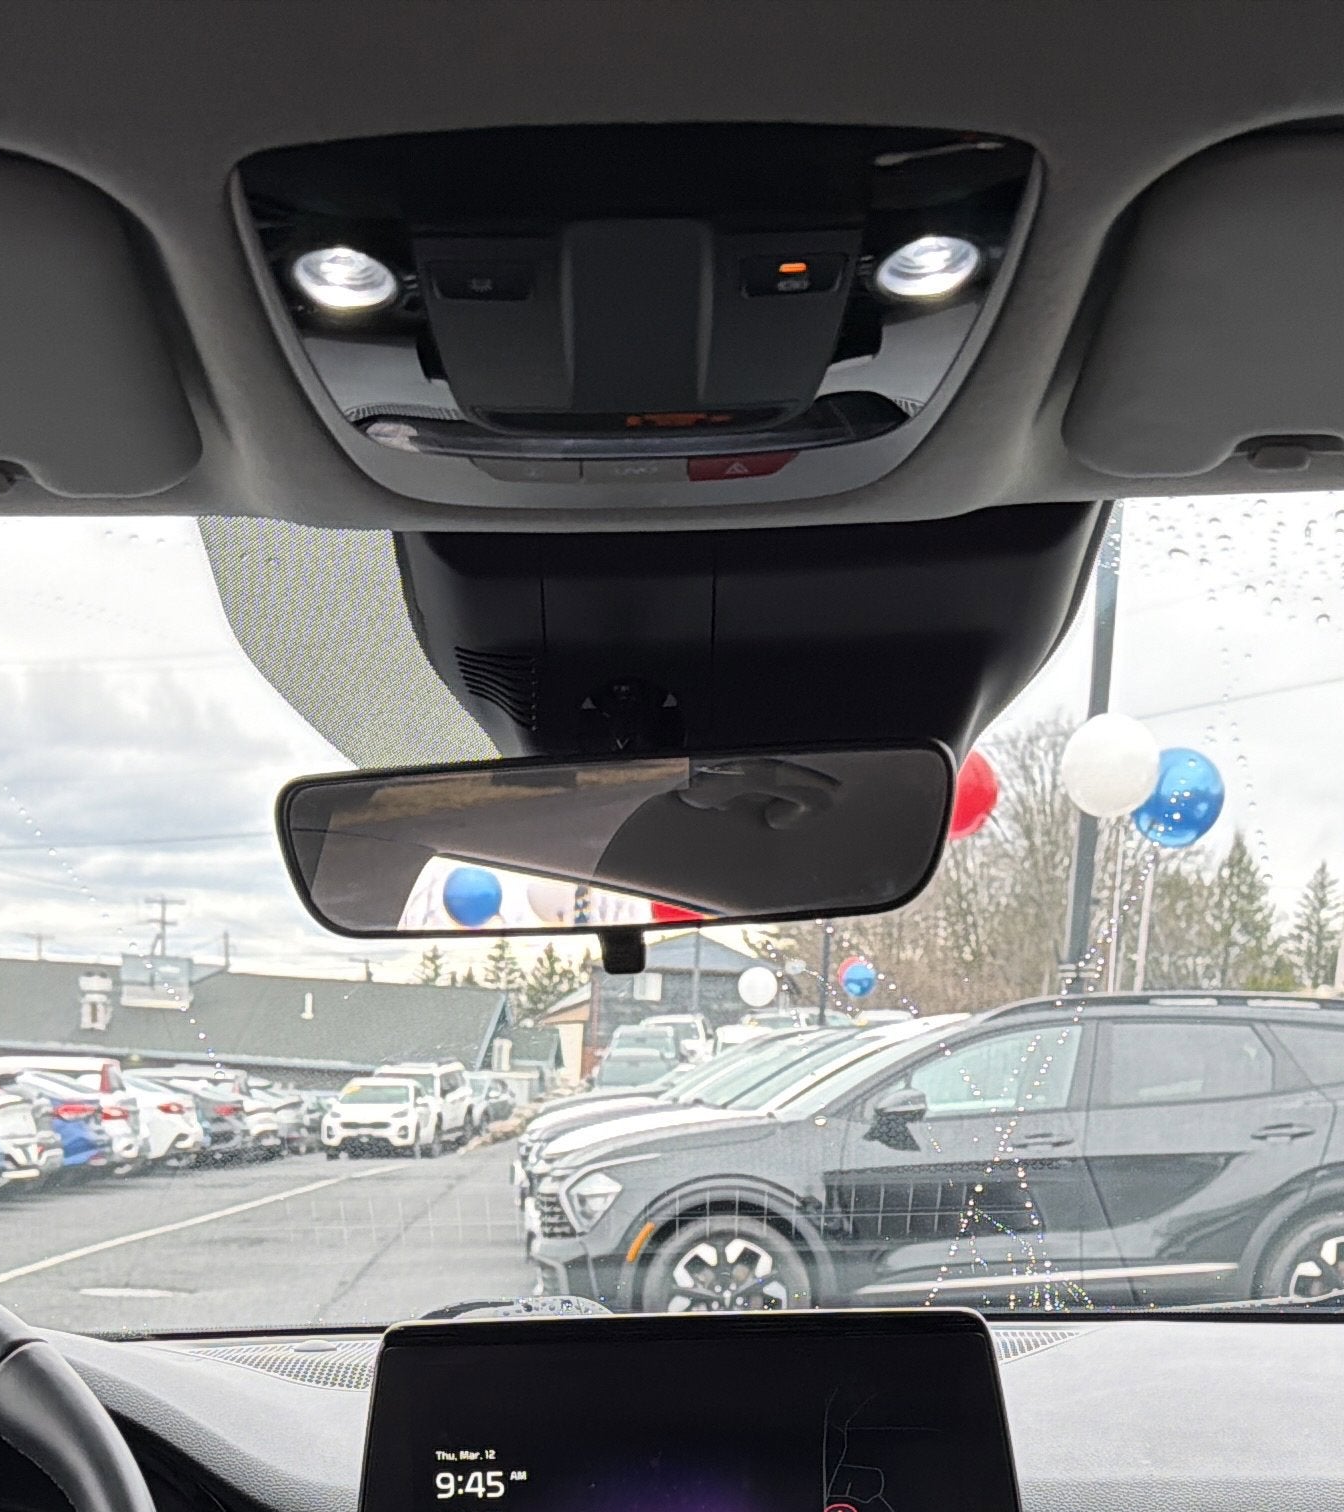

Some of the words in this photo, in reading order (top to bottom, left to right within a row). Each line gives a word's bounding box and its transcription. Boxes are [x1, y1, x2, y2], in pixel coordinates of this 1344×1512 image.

[485, 1449, 496, 1460] 12
[435, 1470, 505, 1499] 9:45
[510, 1471, 527, 1481] AM
